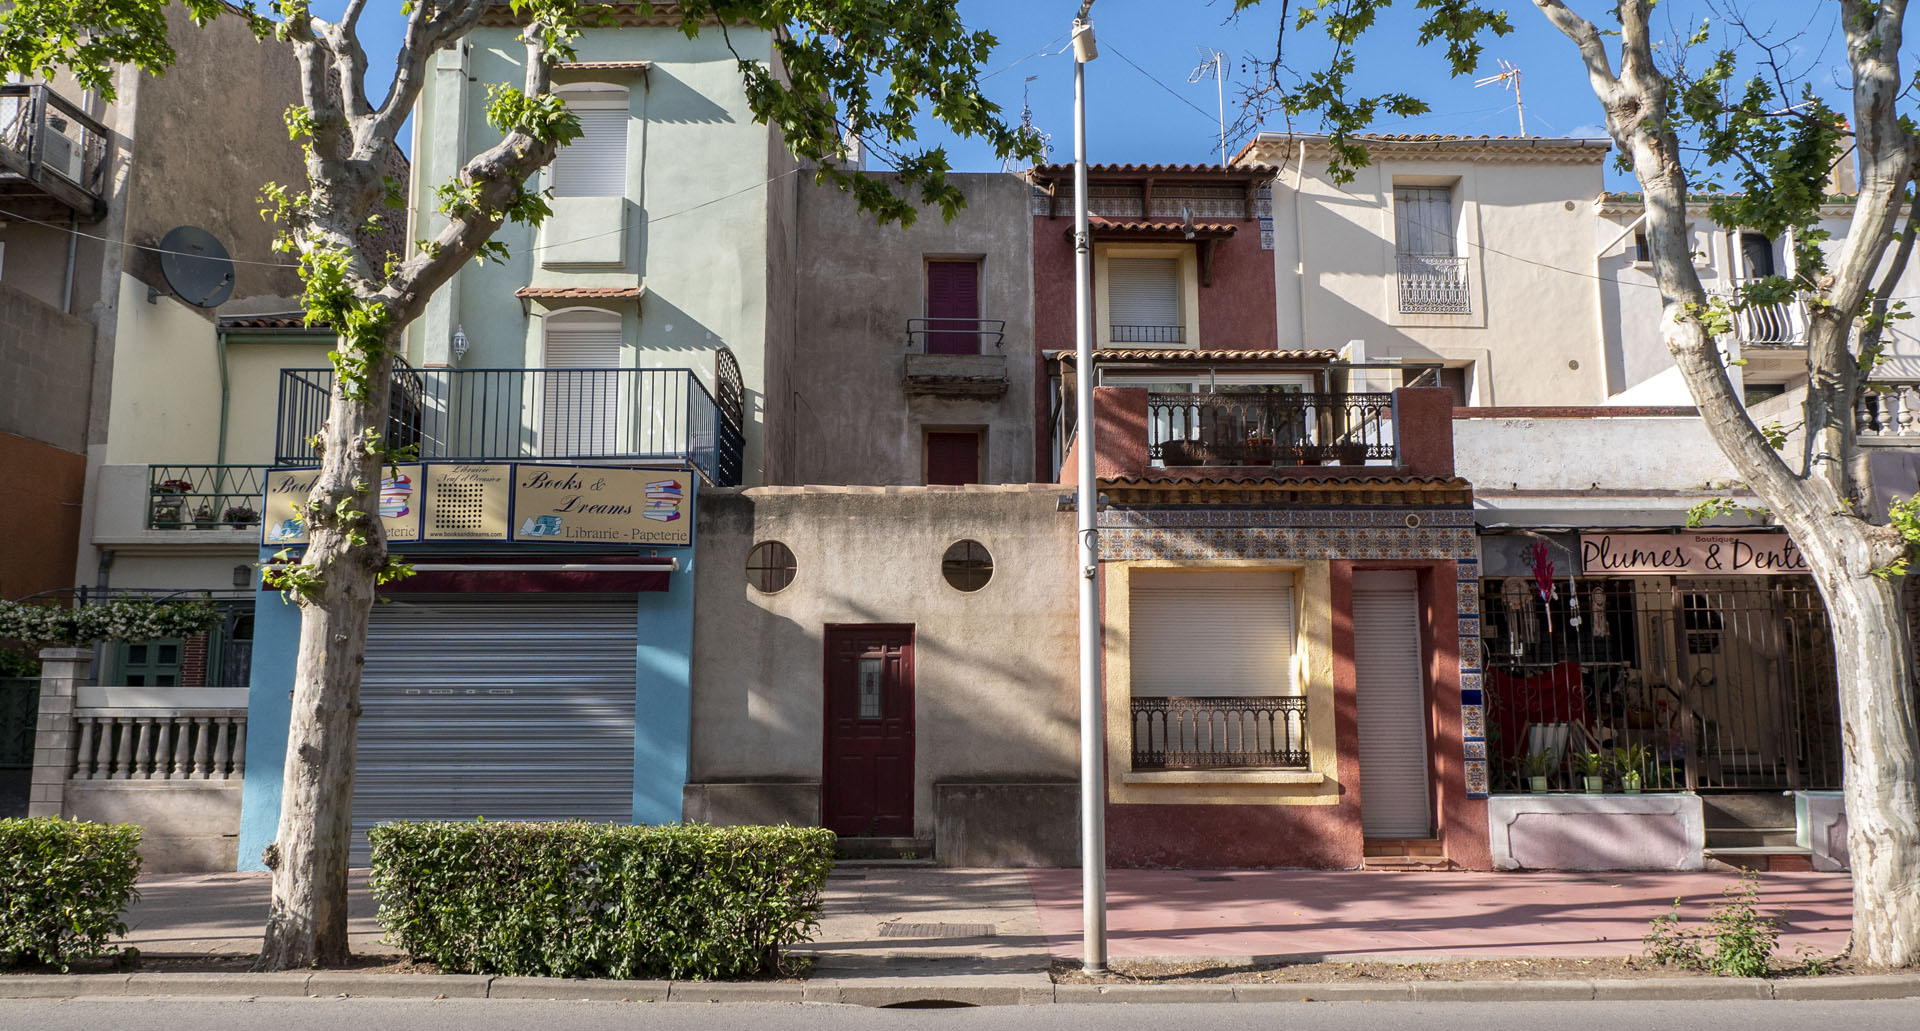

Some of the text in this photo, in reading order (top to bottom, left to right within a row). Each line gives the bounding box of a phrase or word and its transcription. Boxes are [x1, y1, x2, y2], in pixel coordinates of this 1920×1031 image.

[272, 474, 321, 494] Book
[522, 470, 606, 492] Books &
[552, 494, 633, 515] Dreams
[565, 526, 620, 540] Librairie
[631, 528, 688, 542] Papeterie
[1695, 535, 1735, 544] Boutique
[1583, 535, 1808, 571] Plumes & Dente
